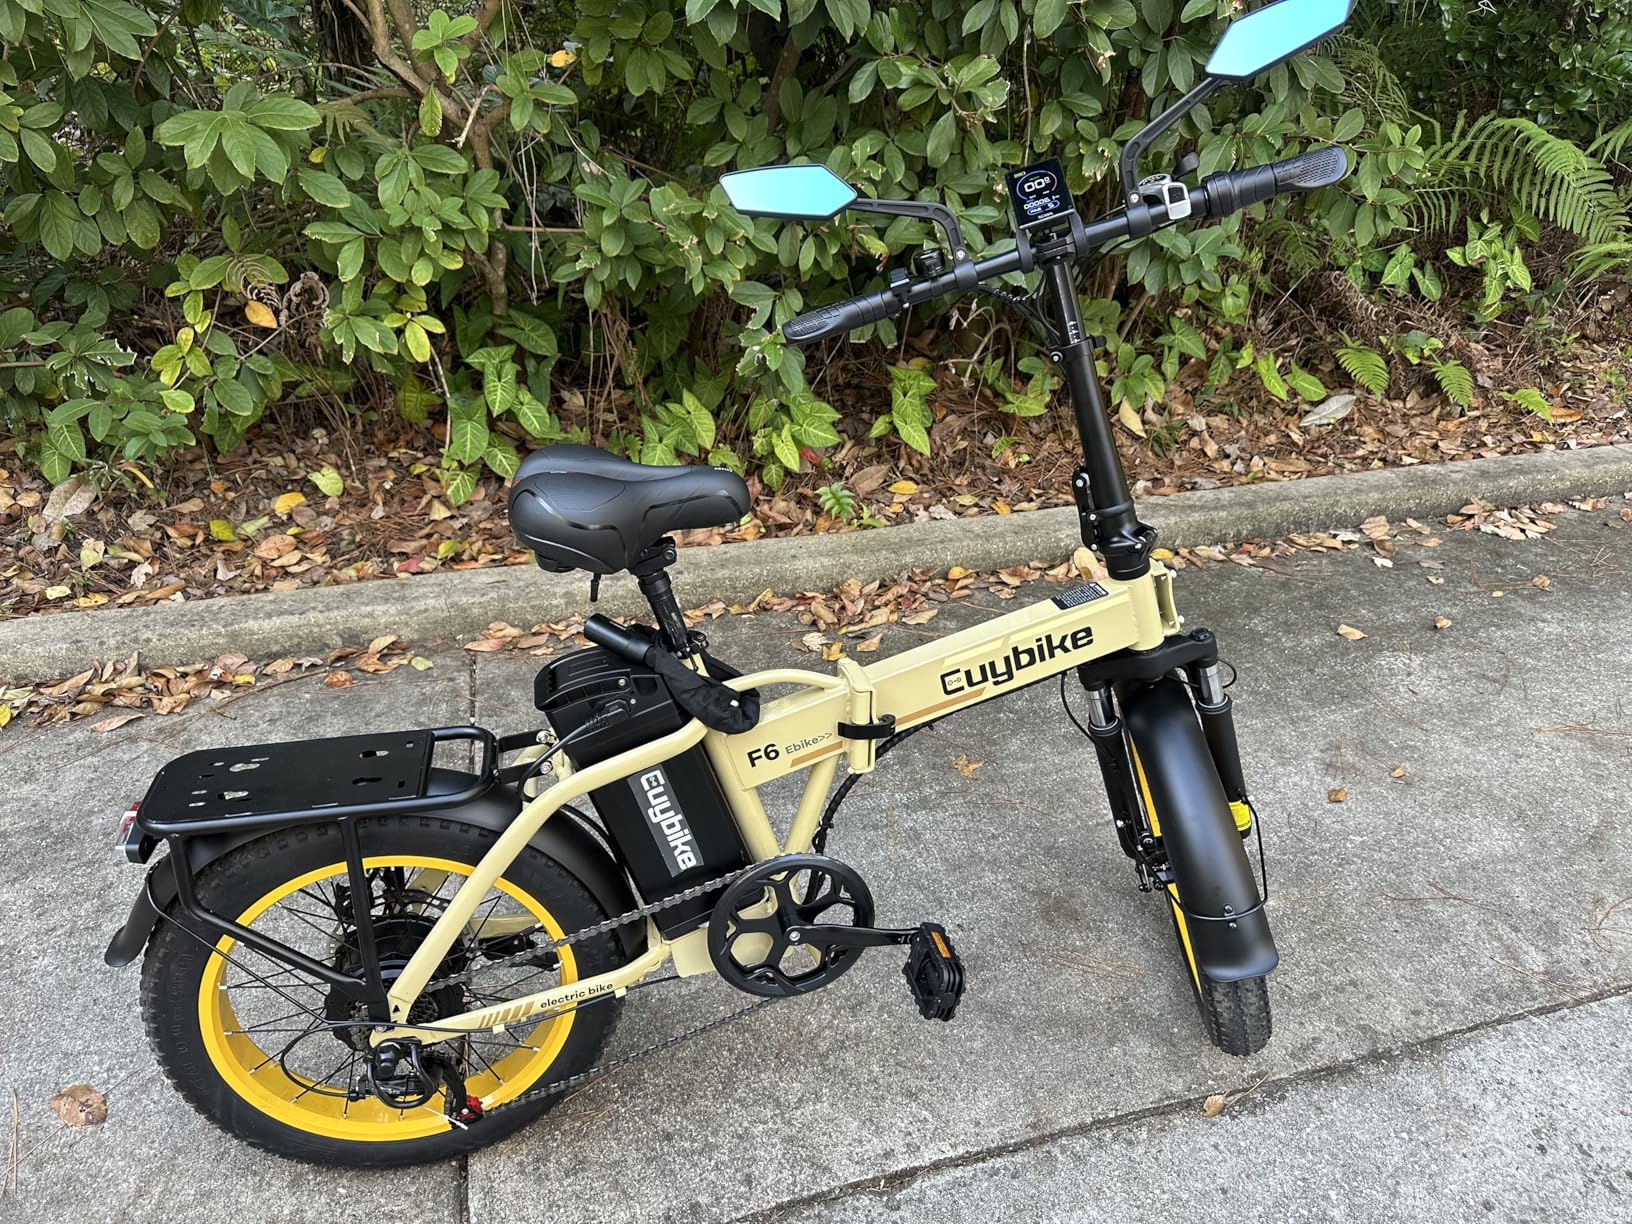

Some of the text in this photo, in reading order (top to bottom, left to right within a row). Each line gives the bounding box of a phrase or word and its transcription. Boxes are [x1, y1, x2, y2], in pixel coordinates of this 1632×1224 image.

[746, 743, 780, 768] F6
[540, 982, 613, 1009] electric bike
